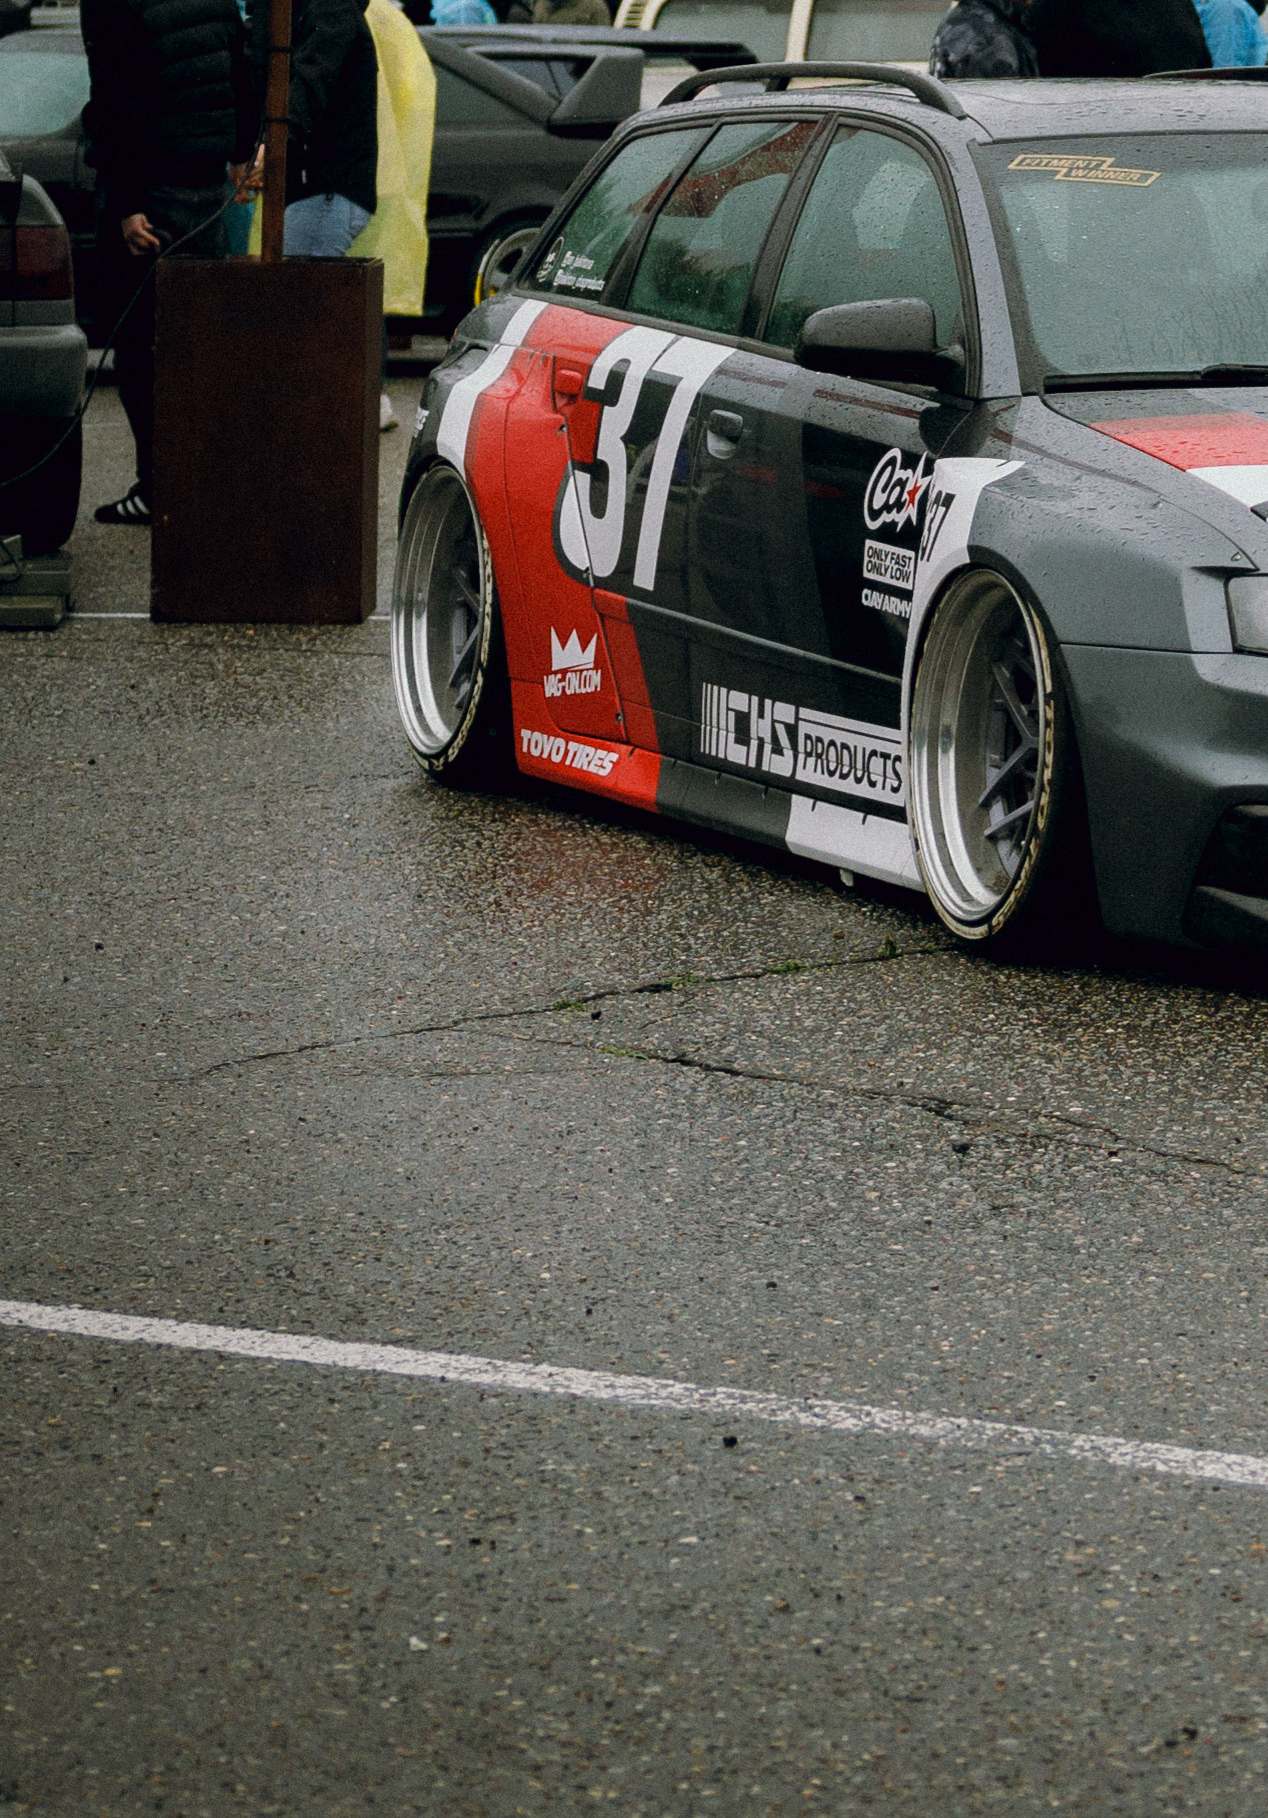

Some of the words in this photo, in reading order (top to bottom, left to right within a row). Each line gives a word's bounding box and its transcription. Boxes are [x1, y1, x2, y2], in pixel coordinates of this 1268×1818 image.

[1022, 157, 1098, 169] FITMENT
[1071, 168, 1142, 181] WINNER
[560, 324, 738, 592] 37
[867, 545, 890, 563] ONLY
[890, 551, 912, 570] FAST
[865, 559, 890, 578] ONLY
[890, 565, 912, 584] LOW
[543, 668, 602, 698] VAG-ON.COM
[520, 728, 566, 764] TOYO
[565, 740, 620, 777] TIRES
[803, 732, 903, 795] PRODUCTS
